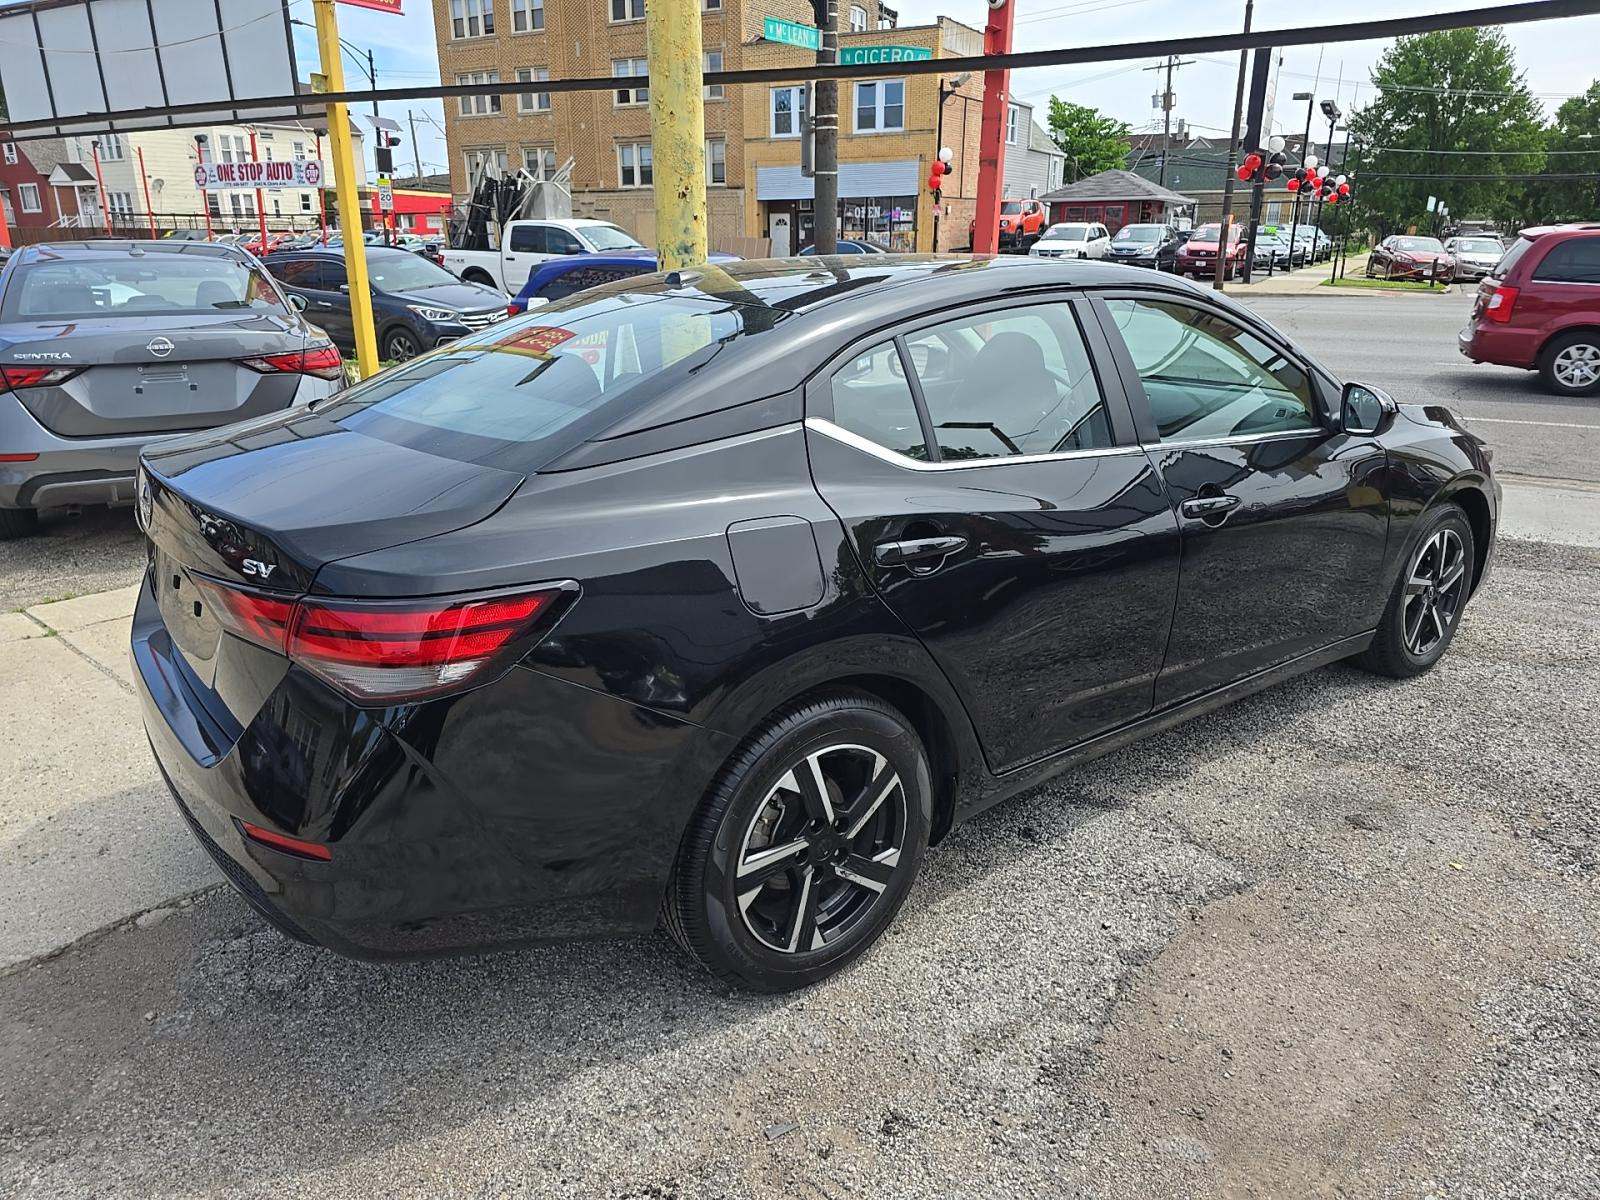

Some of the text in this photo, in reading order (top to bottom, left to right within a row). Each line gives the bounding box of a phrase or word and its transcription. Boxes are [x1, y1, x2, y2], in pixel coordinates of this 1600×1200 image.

[845, 53, 851, 62] N
[854, 48, 914, 64] CICERO
[217, 164, 236, 181] ONE
[238, 163, 263, 181] STOP
[266, 162, 293, 180] AUTO
[380, 193, 392, 202] 20
[854, 206, 881, 219] OPEN
[13, 352, 72, 360] SENTRA
[242, 558, 277, 578] SV
